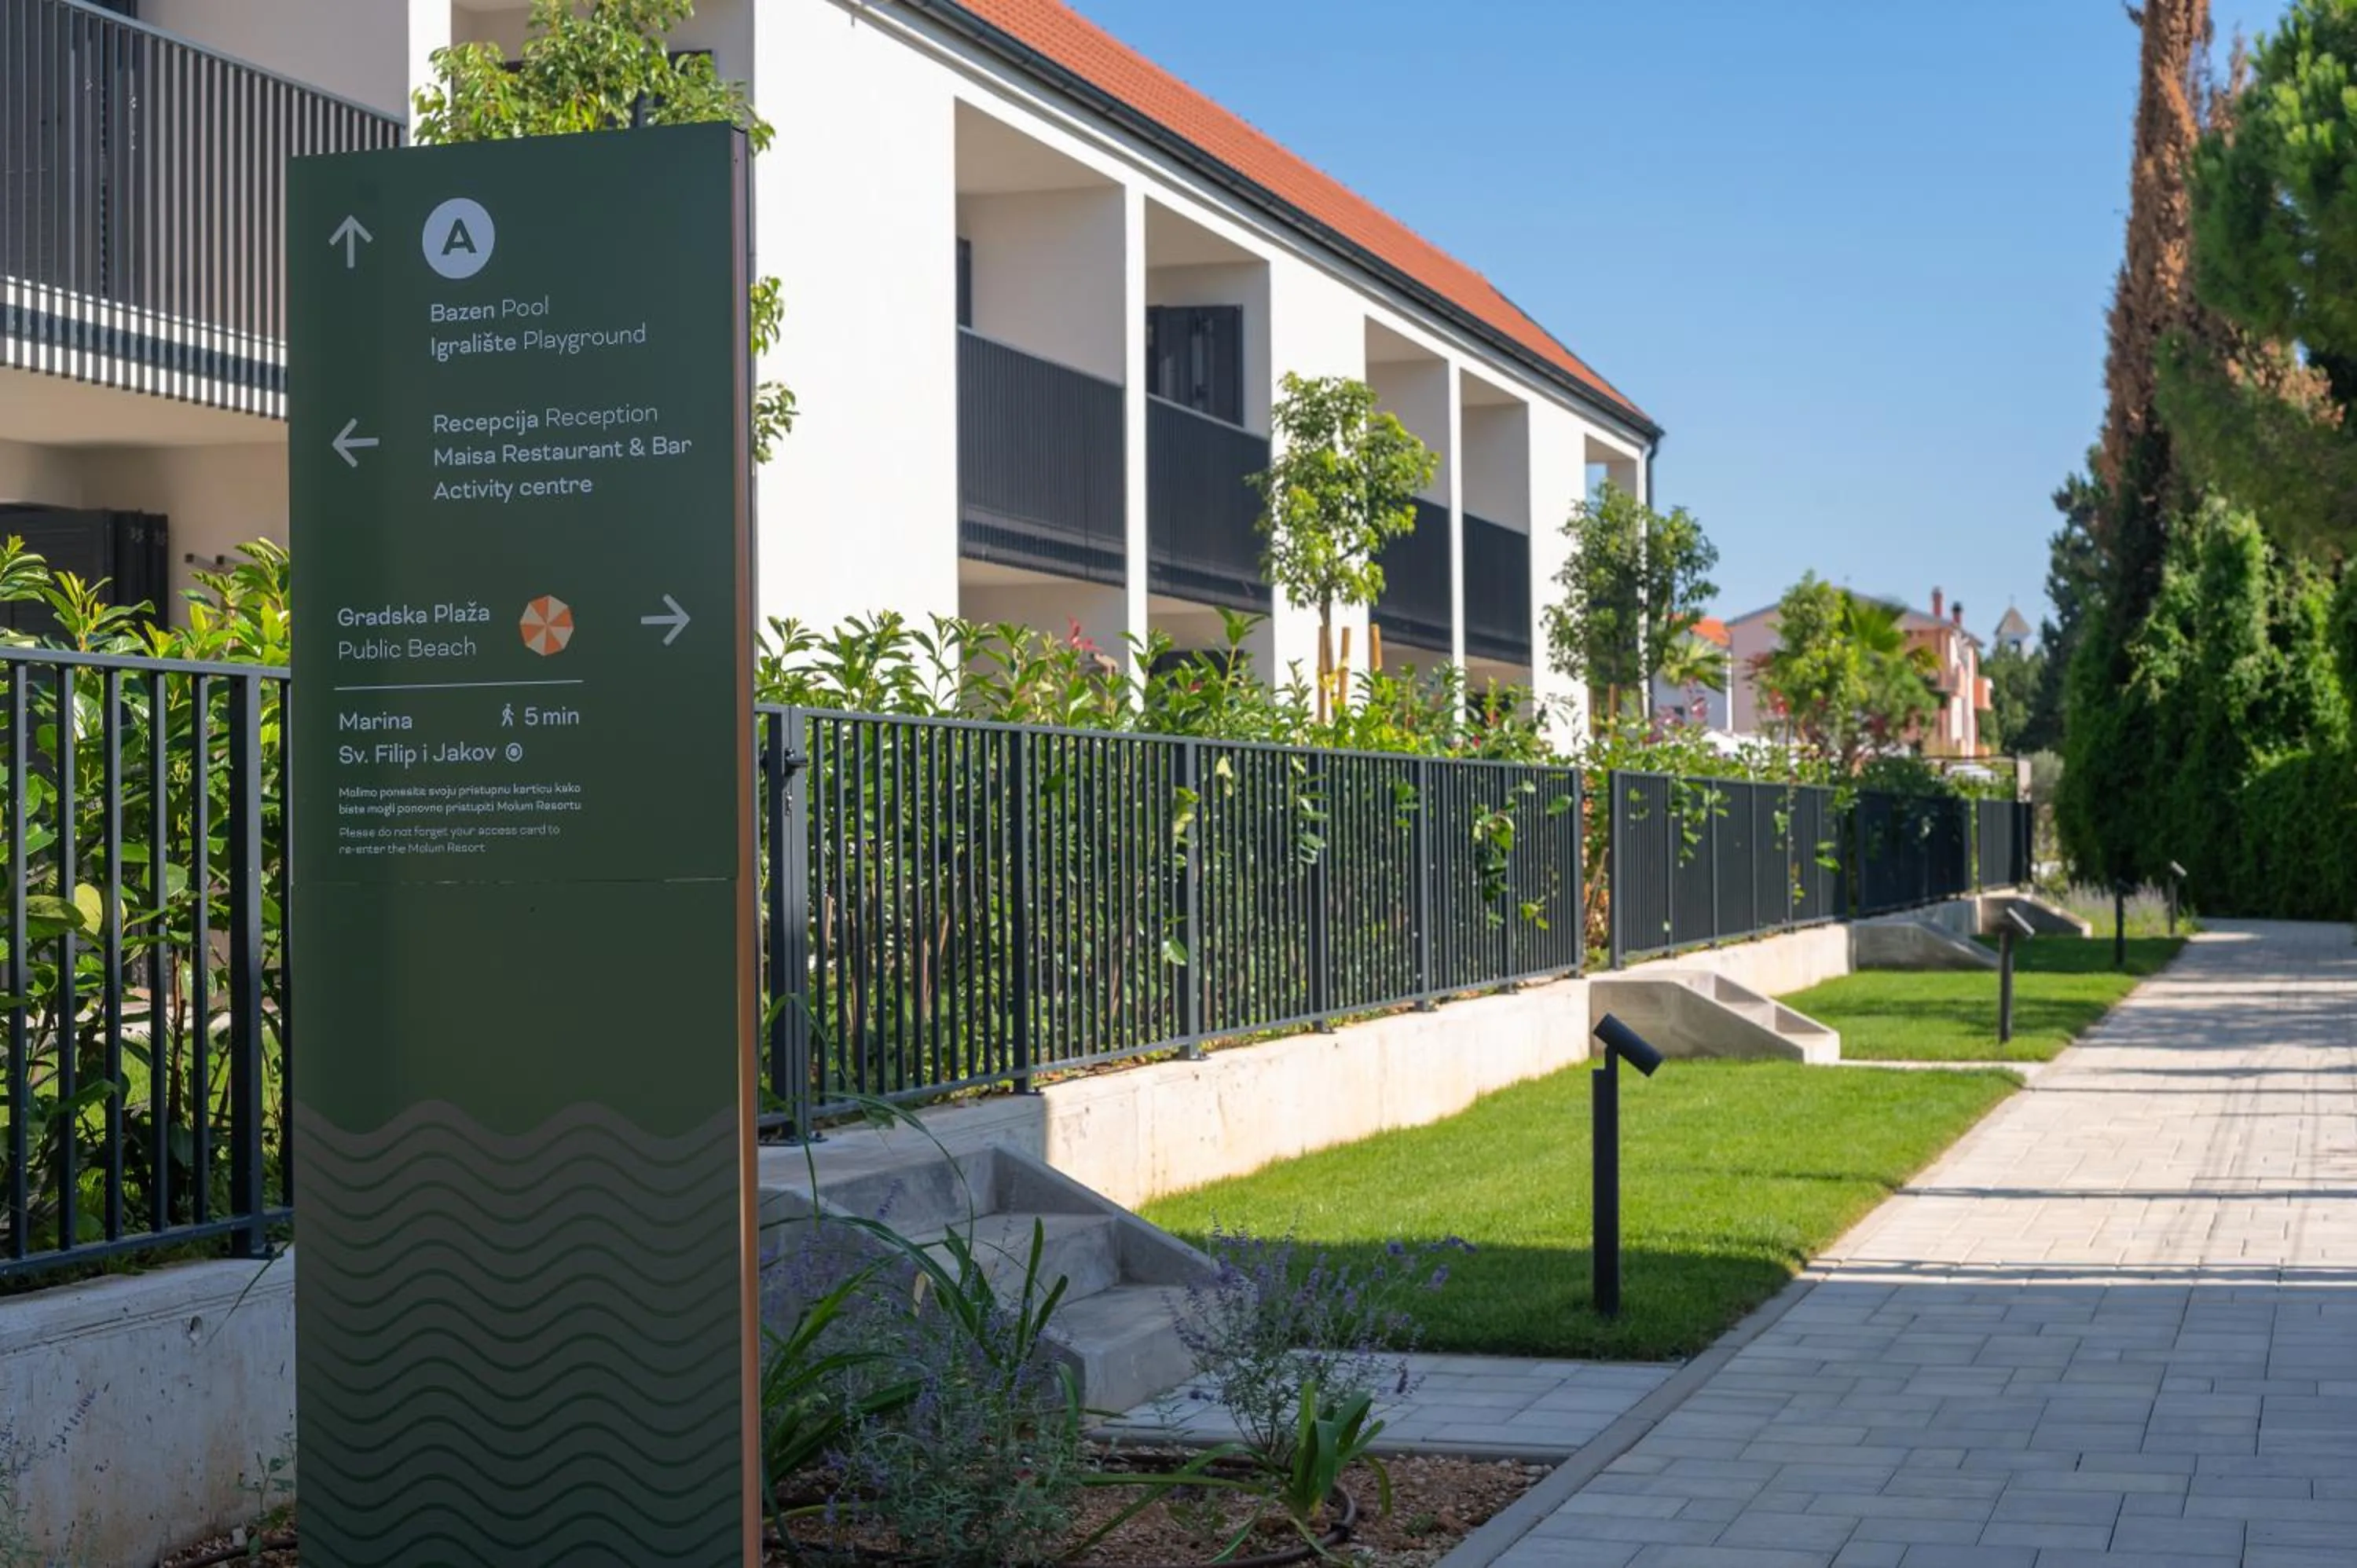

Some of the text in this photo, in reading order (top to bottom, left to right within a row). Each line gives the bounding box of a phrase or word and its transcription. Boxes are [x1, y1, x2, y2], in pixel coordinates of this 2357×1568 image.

[441, 218, 477, 255] A
[431, 295, 549, 323] Bazen Pool
[431, 321, 646, 362] Igralište Playground
[434, 404, 658, 438] Recepcija Reception
[434, 436, 692, 466] Maisa Restaurant & Bar
[433, 477, 593, 504] Activity centre
[337, 601, 490, 627] Gradska Plaža
[339, 636, 477, 660] Public Beach
[339, 711, 413, 731] Marina
[524, 705, 580, 727] 5 min
[339, 741, 497, 771] Sv. Filip i Jakov
